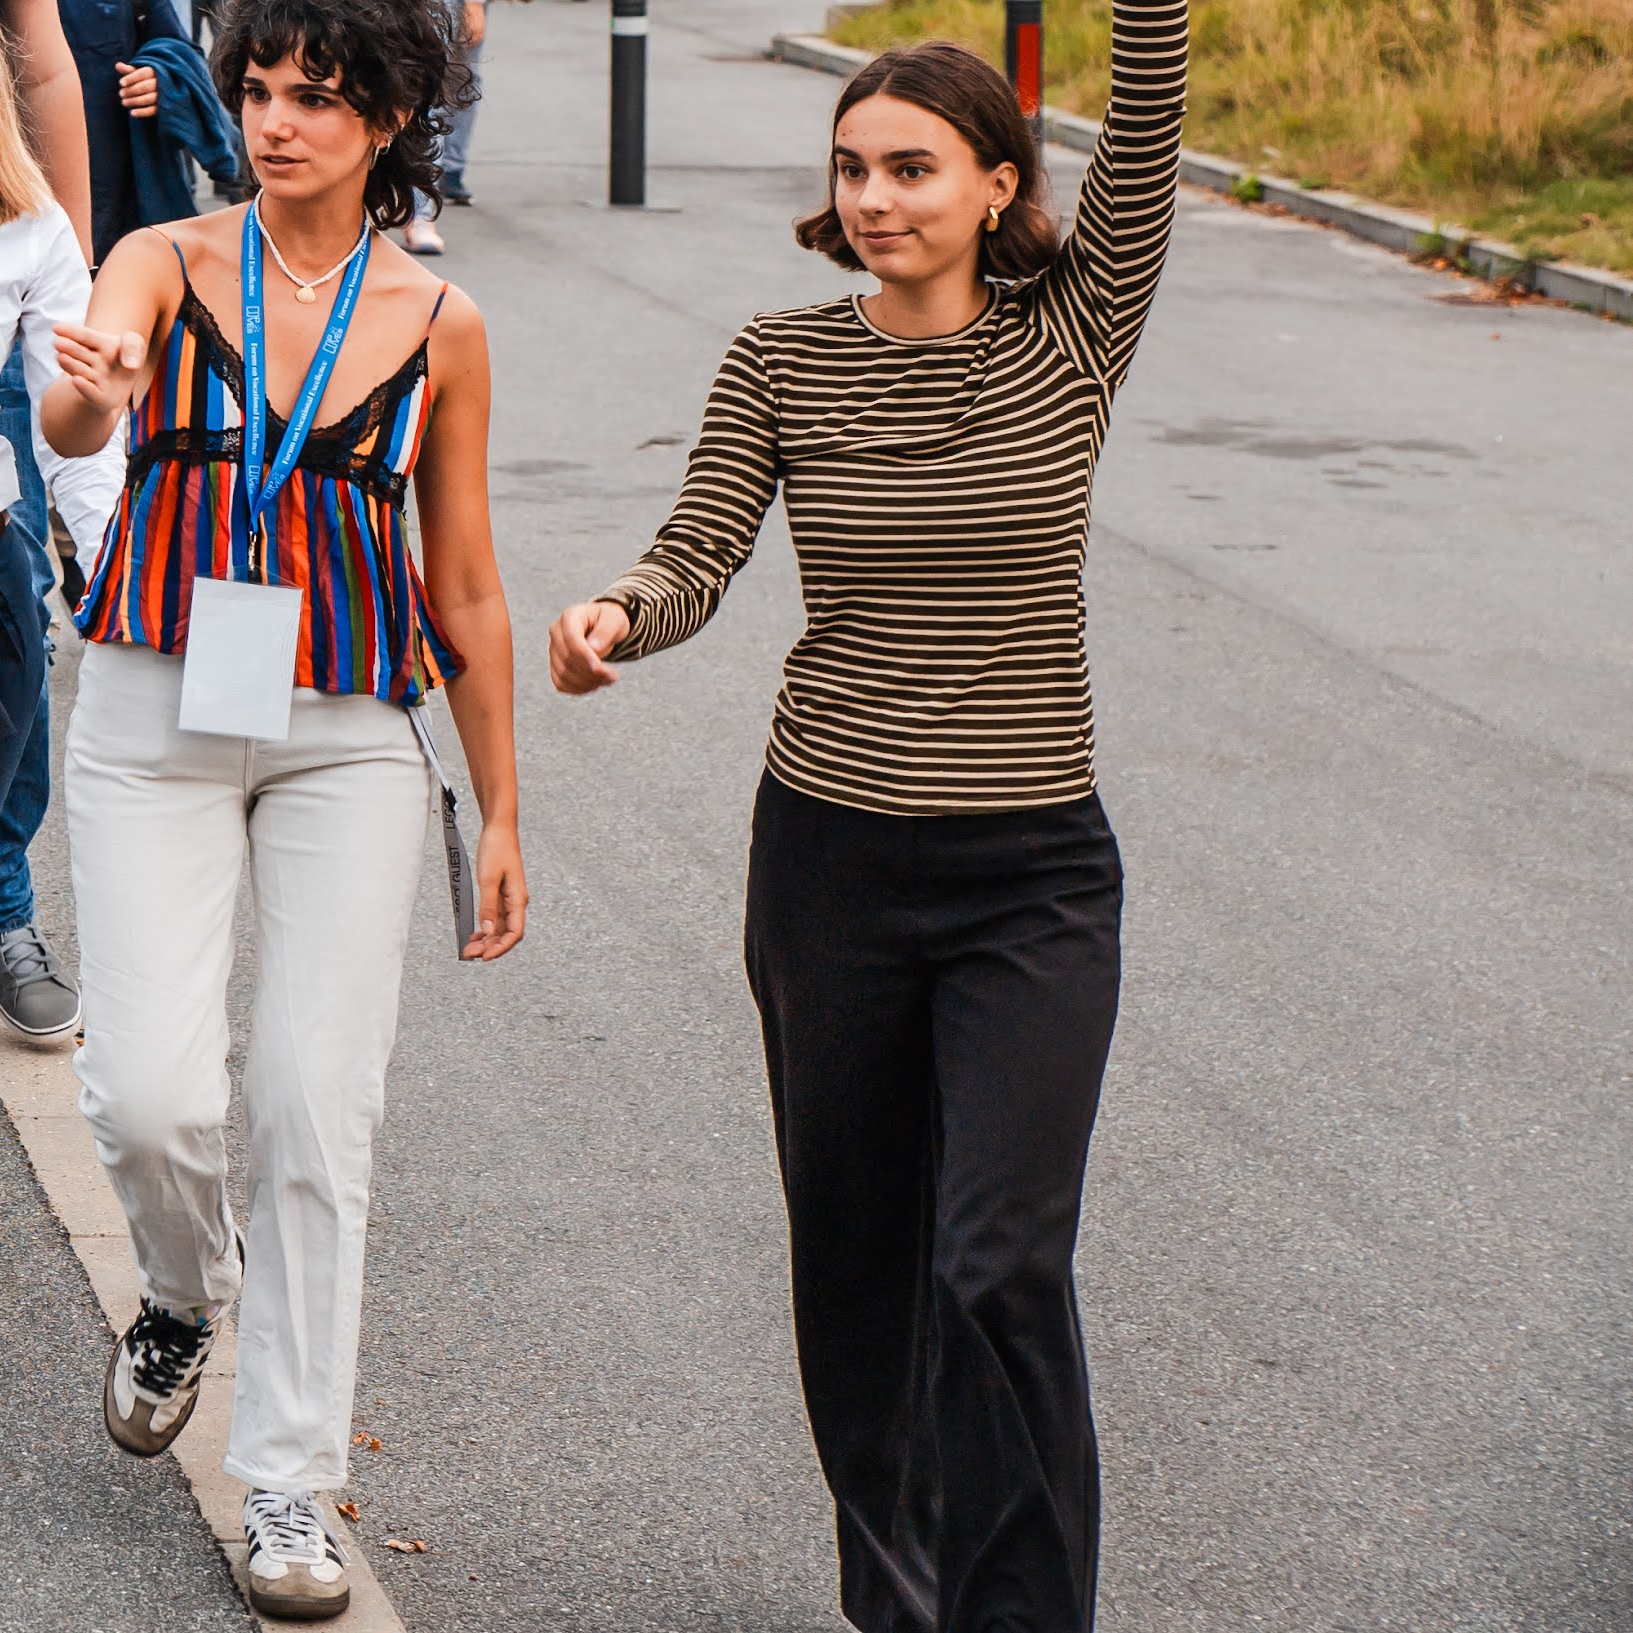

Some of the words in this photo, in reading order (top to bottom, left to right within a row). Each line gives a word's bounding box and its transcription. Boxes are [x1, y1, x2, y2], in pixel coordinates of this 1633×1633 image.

[248, 261, 256, 296] Excellence
[338, 297, 350, 319] Forum
[348, 254, 363, 288] Vocational
[308, 361, 327, 397] Excellence
[294, 395, 314, 431] Vocational
[252, 416, 260, 455] Excellence
[282, 442, 296, 465] Forum
[293, 432, 300, 442] on
[447, 843, 463, 883] GUEST
